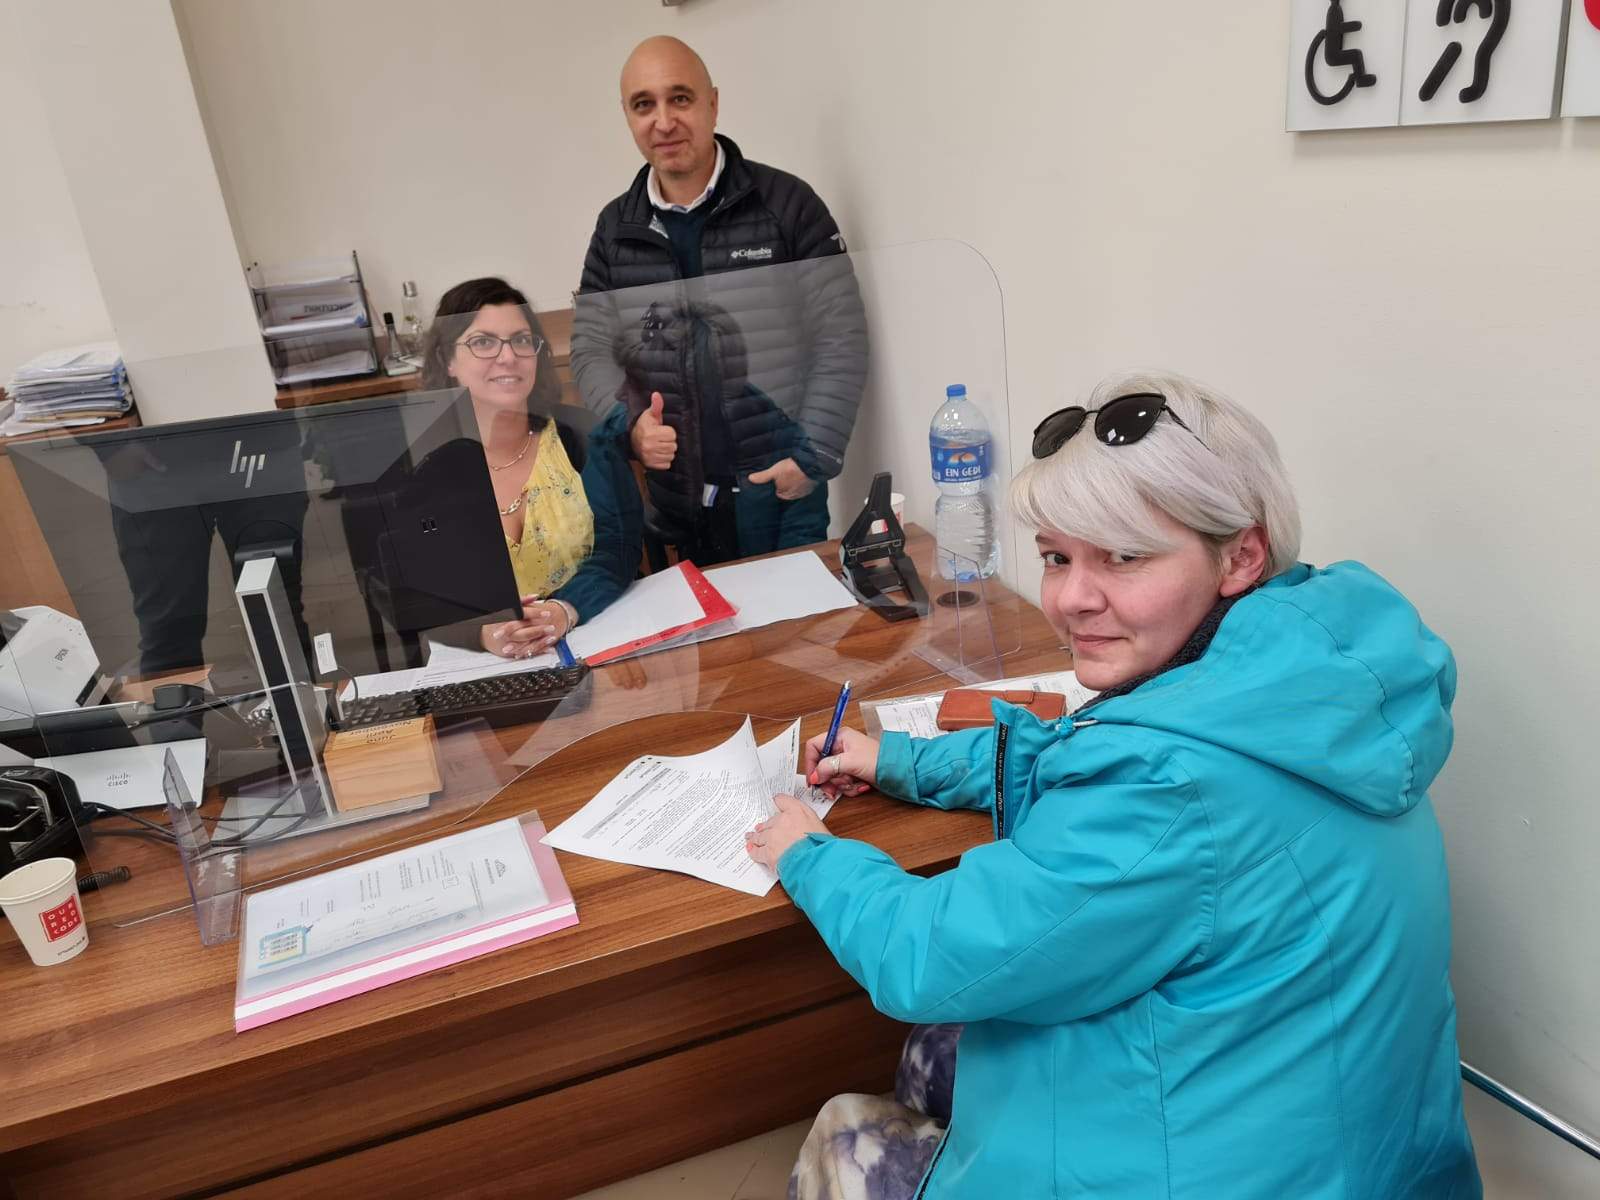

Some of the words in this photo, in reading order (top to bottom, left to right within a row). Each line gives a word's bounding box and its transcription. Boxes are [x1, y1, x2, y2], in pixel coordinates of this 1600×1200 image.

[739, 247, 772, 257] Columbia
[945, 468, 960, 477] EIN
[961, 465, 982, 476] GEDI
